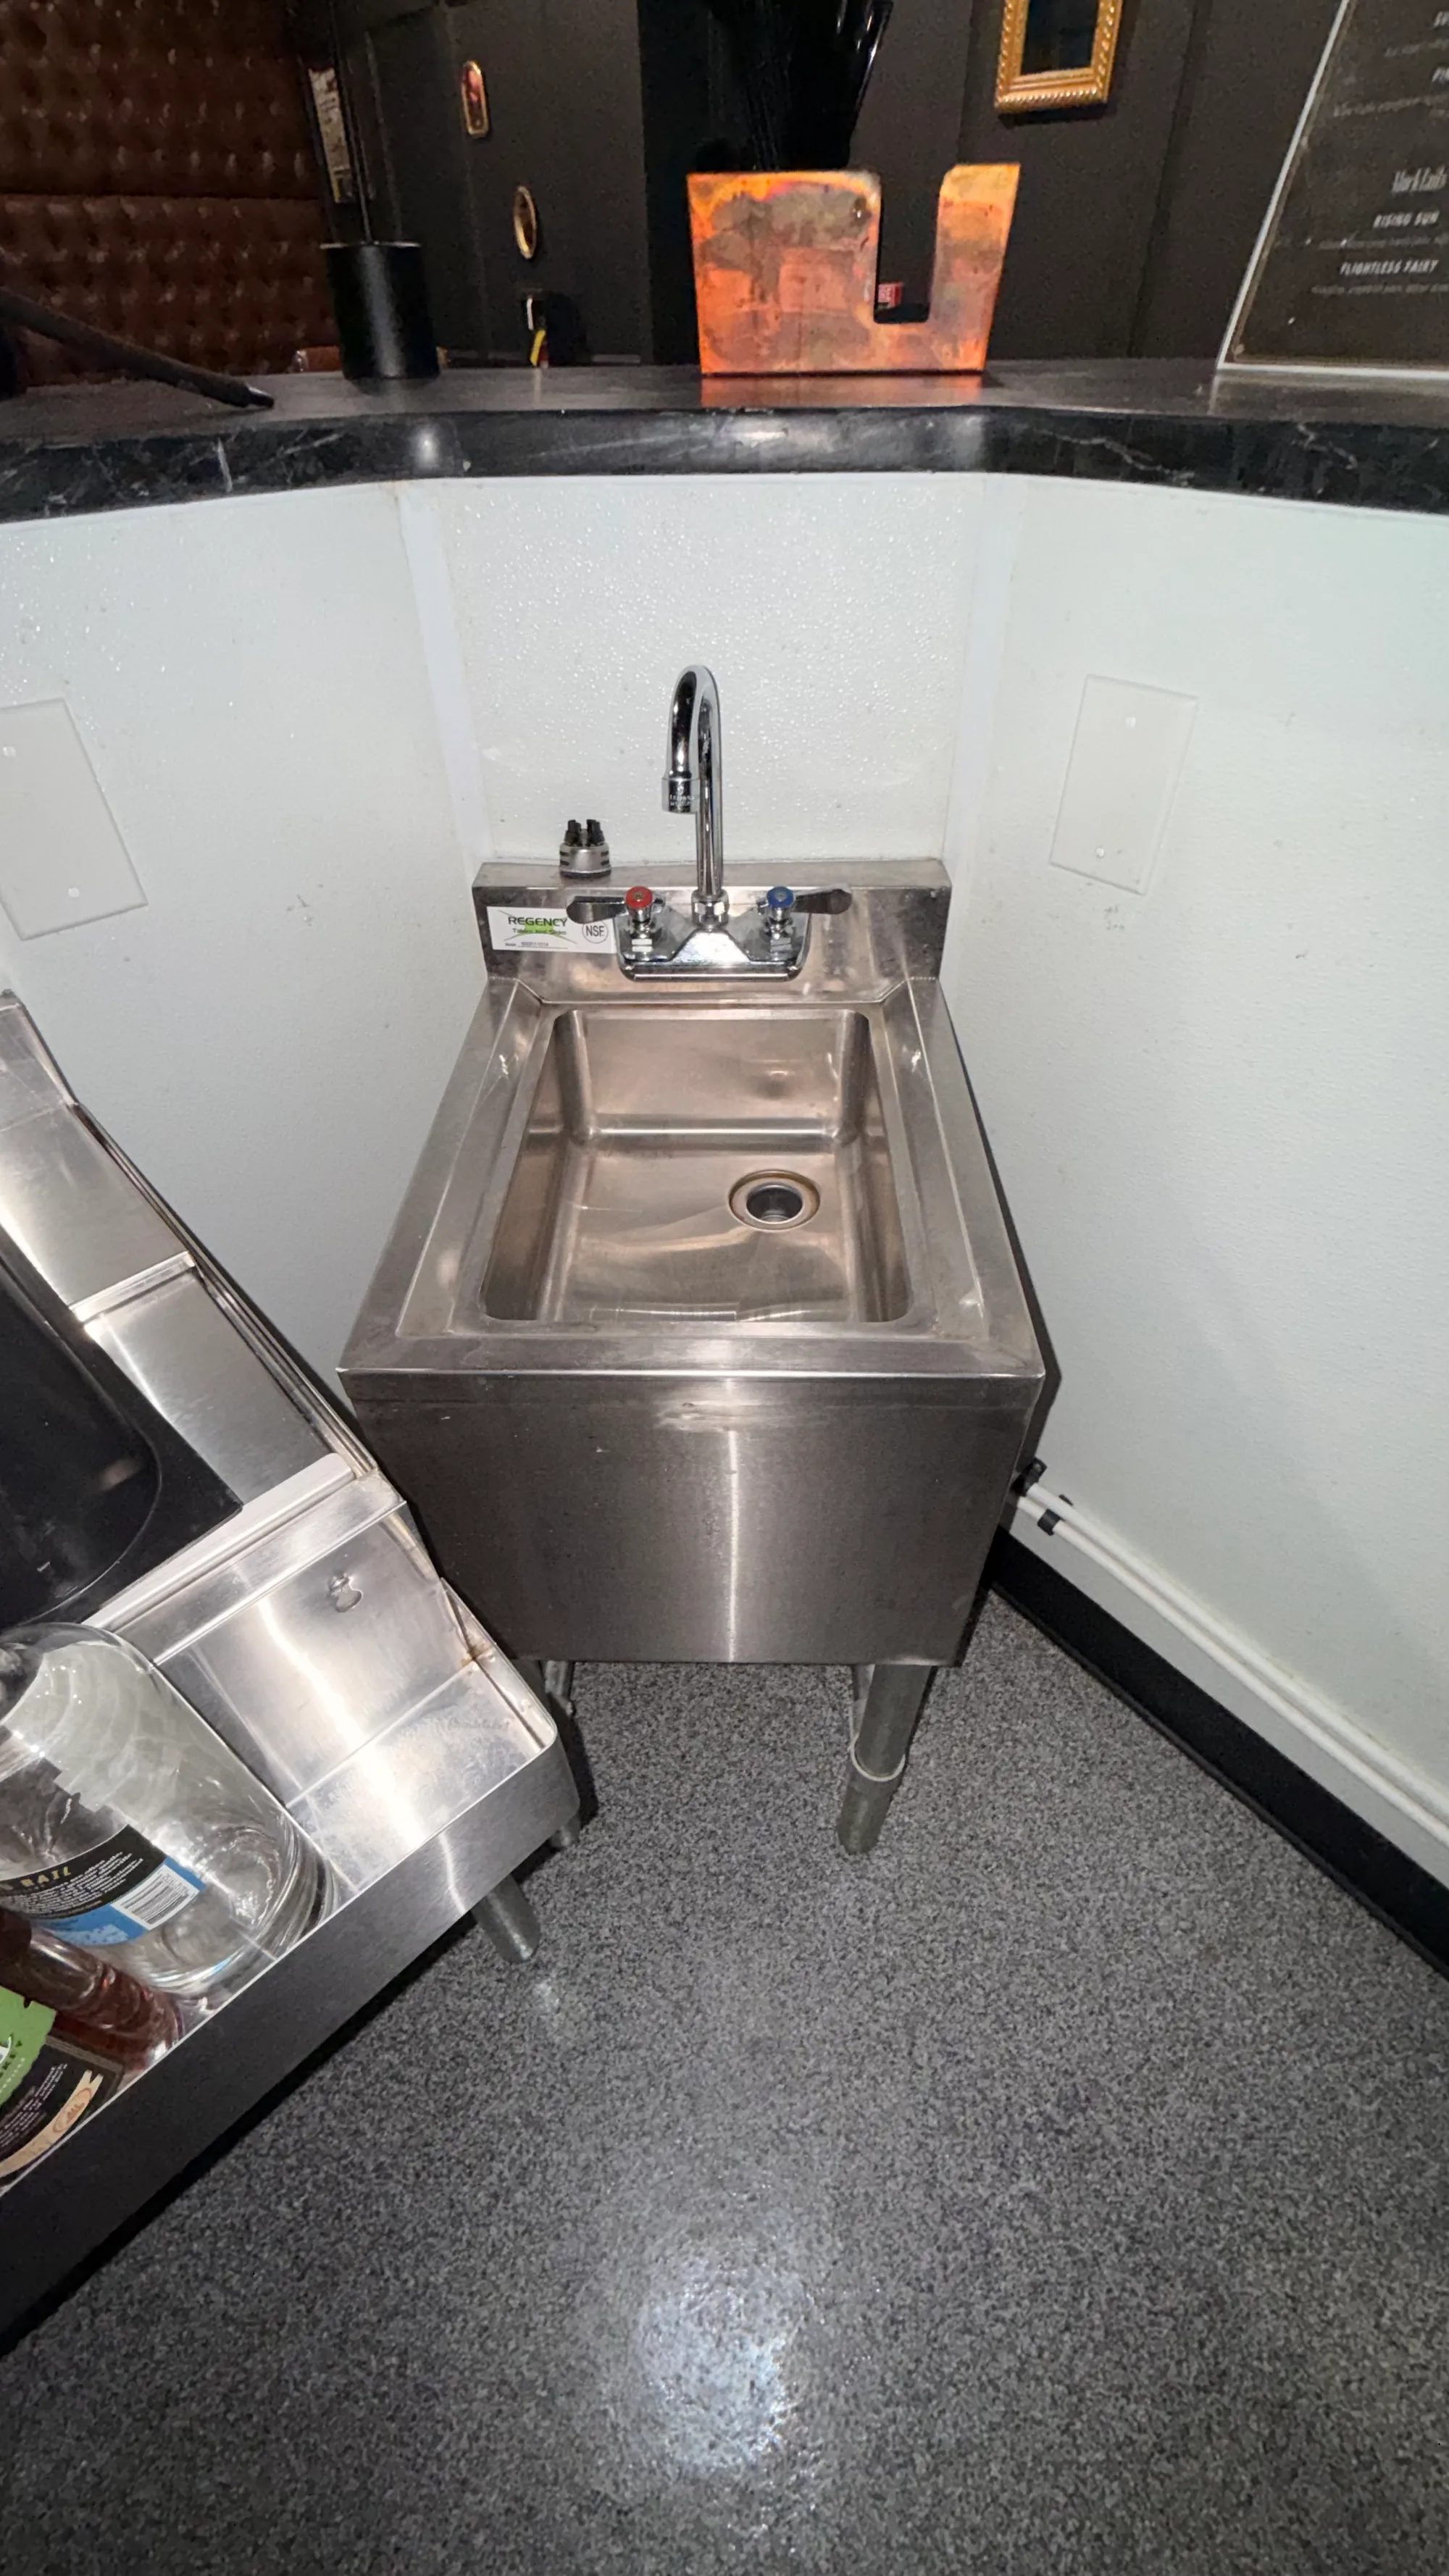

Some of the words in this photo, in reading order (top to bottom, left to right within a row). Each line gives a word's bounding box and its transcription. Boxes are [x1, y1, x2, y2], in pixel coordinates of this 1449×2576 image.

[1340, 260, 1403, 276] FLIGHTLESS
[1403, 259, 1440, 273] FAIRY
[508, 916, 568, 927] REGENCY
[585, 925, 604, 937] NSF
